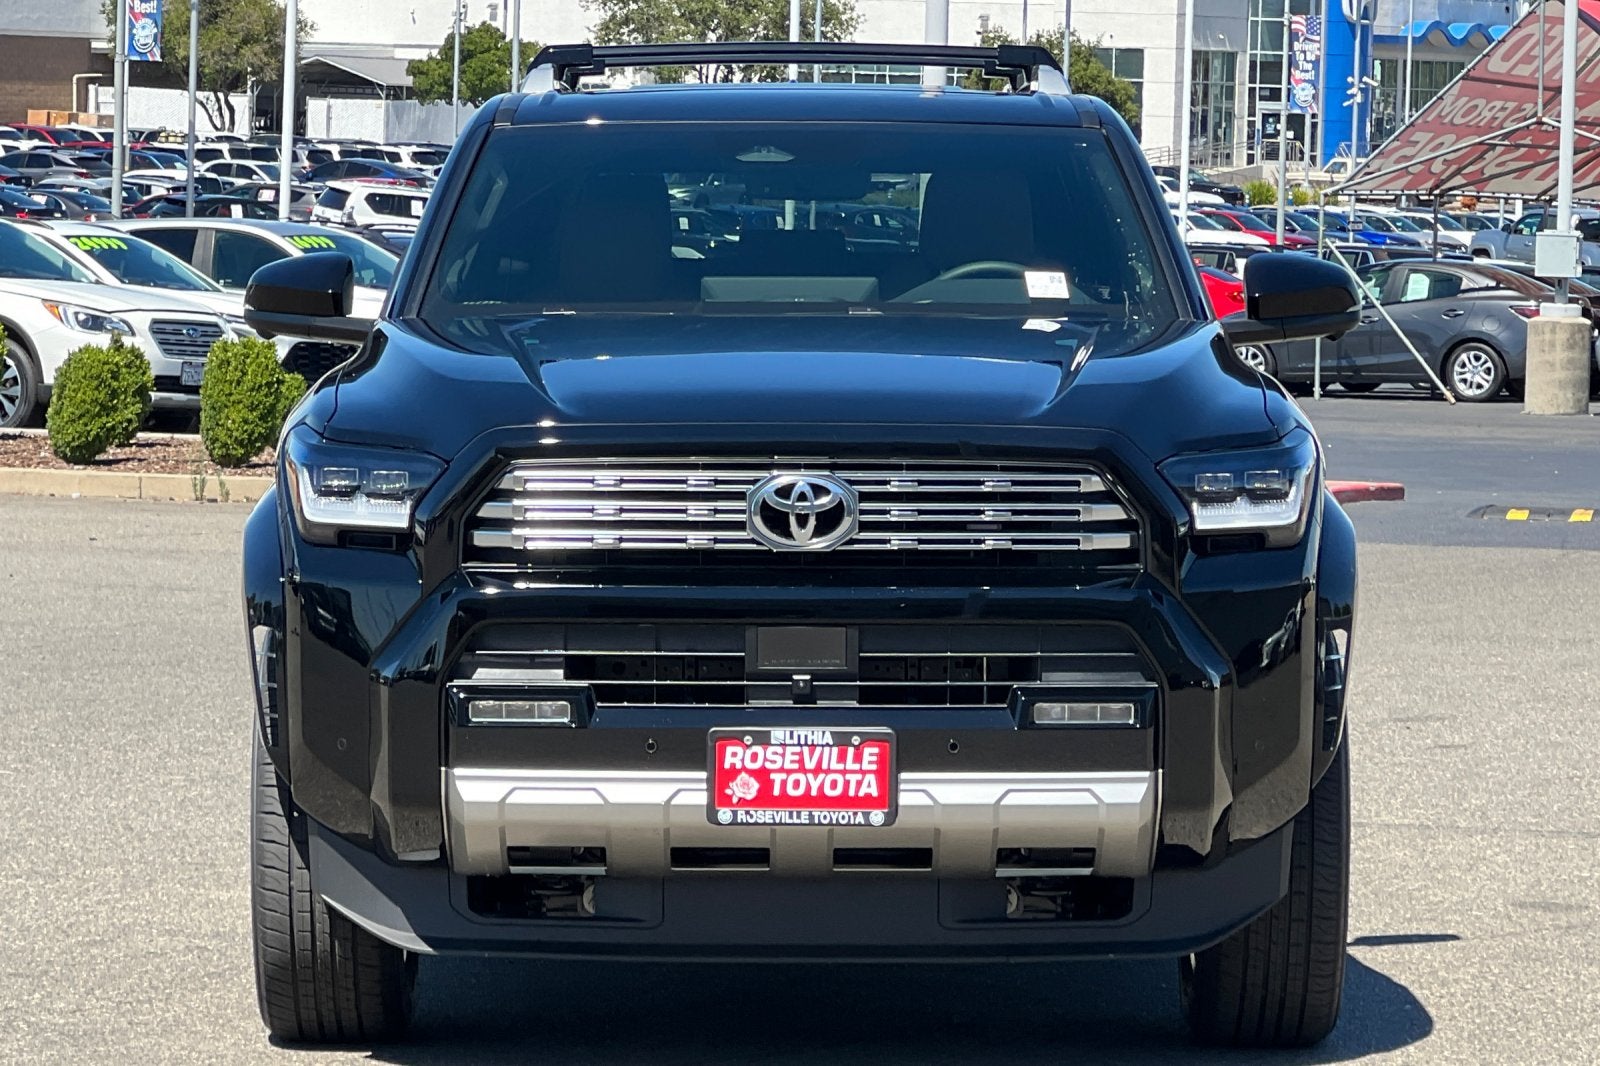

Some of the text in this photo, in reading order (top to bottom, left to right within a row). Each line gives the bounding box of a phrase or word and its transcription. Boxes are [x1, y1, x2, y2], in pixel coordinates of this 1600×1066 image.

[135, 0, 156, 13] Best!
[786, 730, 833, 745] LITHIA
[723, 745, 879, 770] ROSEVILLE
[770, 773, 879, 797] TOYOTA
[737, 810, 864, 825] ROSEVILLE TOYOTA
